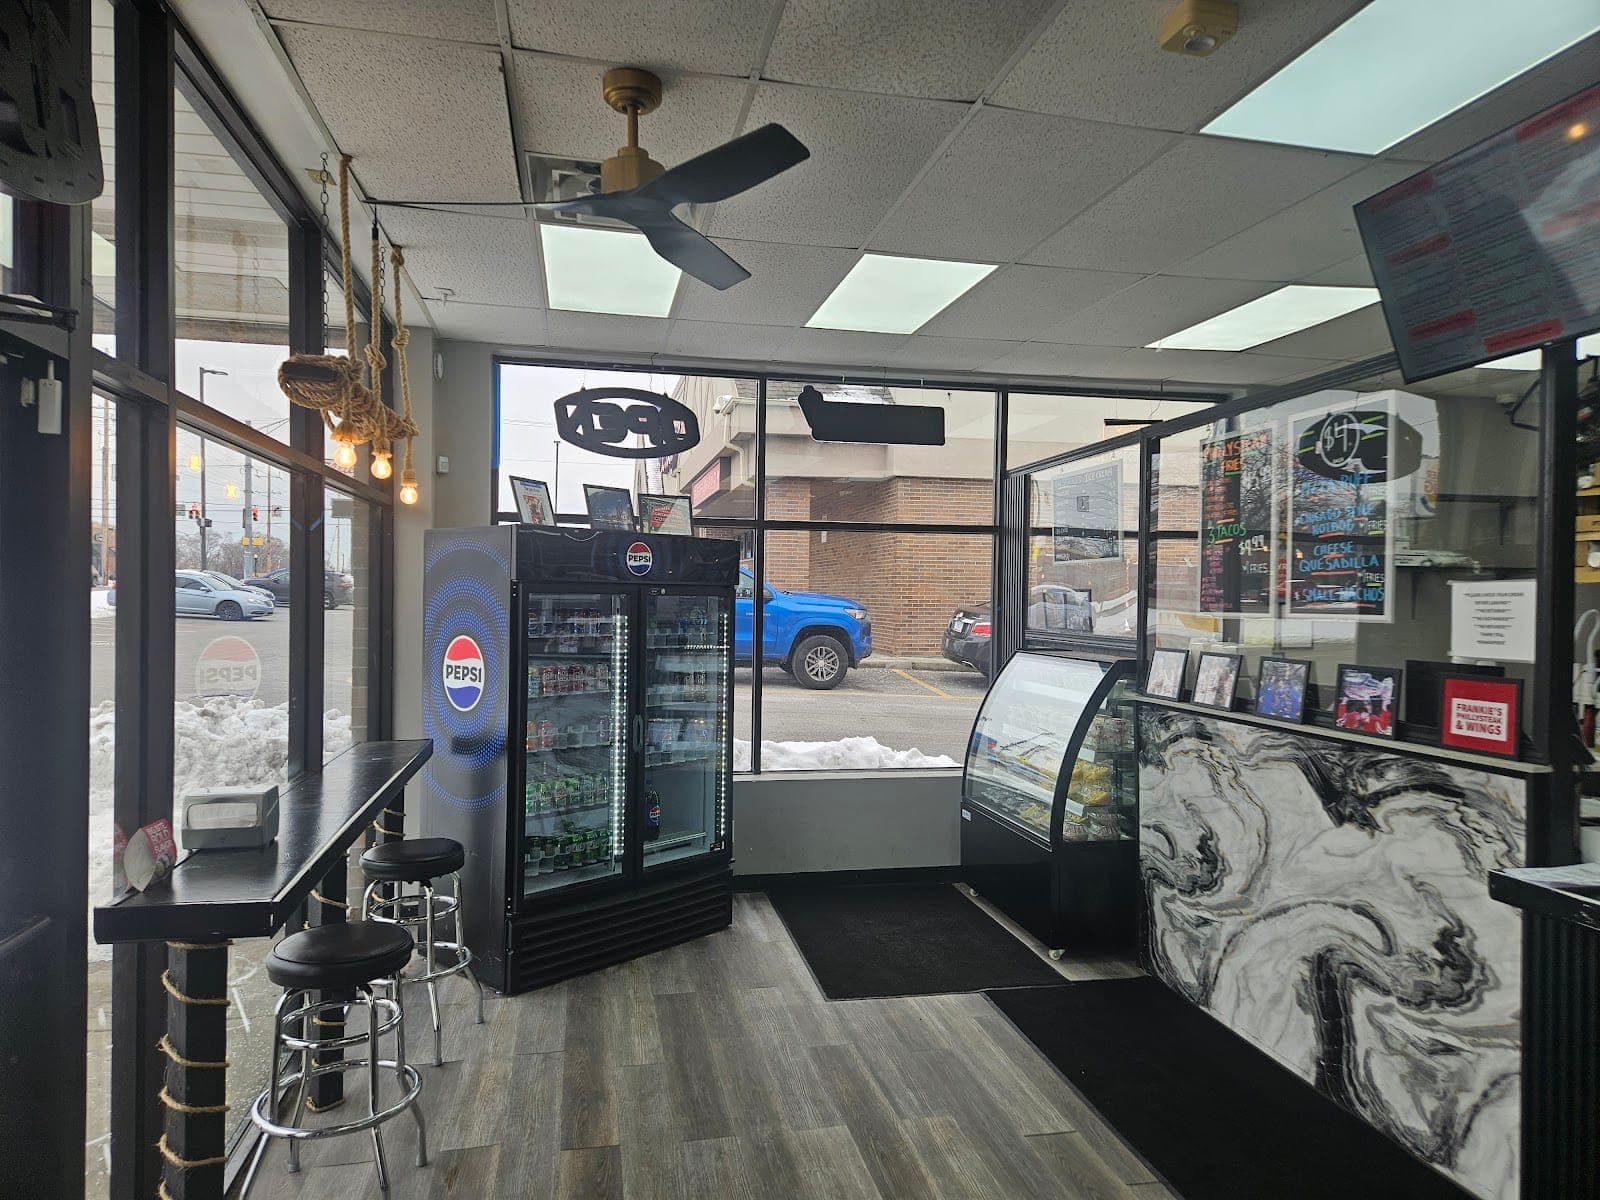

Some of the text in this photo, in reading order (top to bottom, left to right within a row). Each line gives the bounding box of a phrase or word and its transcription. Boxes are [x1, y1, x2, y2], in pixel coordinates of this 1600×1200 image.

[1207, 521, 1247, 544] 3 TACOS
[628, 554, 651, 563] PEPSI
[1299, 554, 1380, 572] QUESADILLA
[446, 664, 482, 683] PEPSI
[1456, 703, 1502, 717] FRANKIE'S
[1456, 712, 1502, 724] PHILLYSTEAK
[1455, 720, 1501, 736] & WINGS
